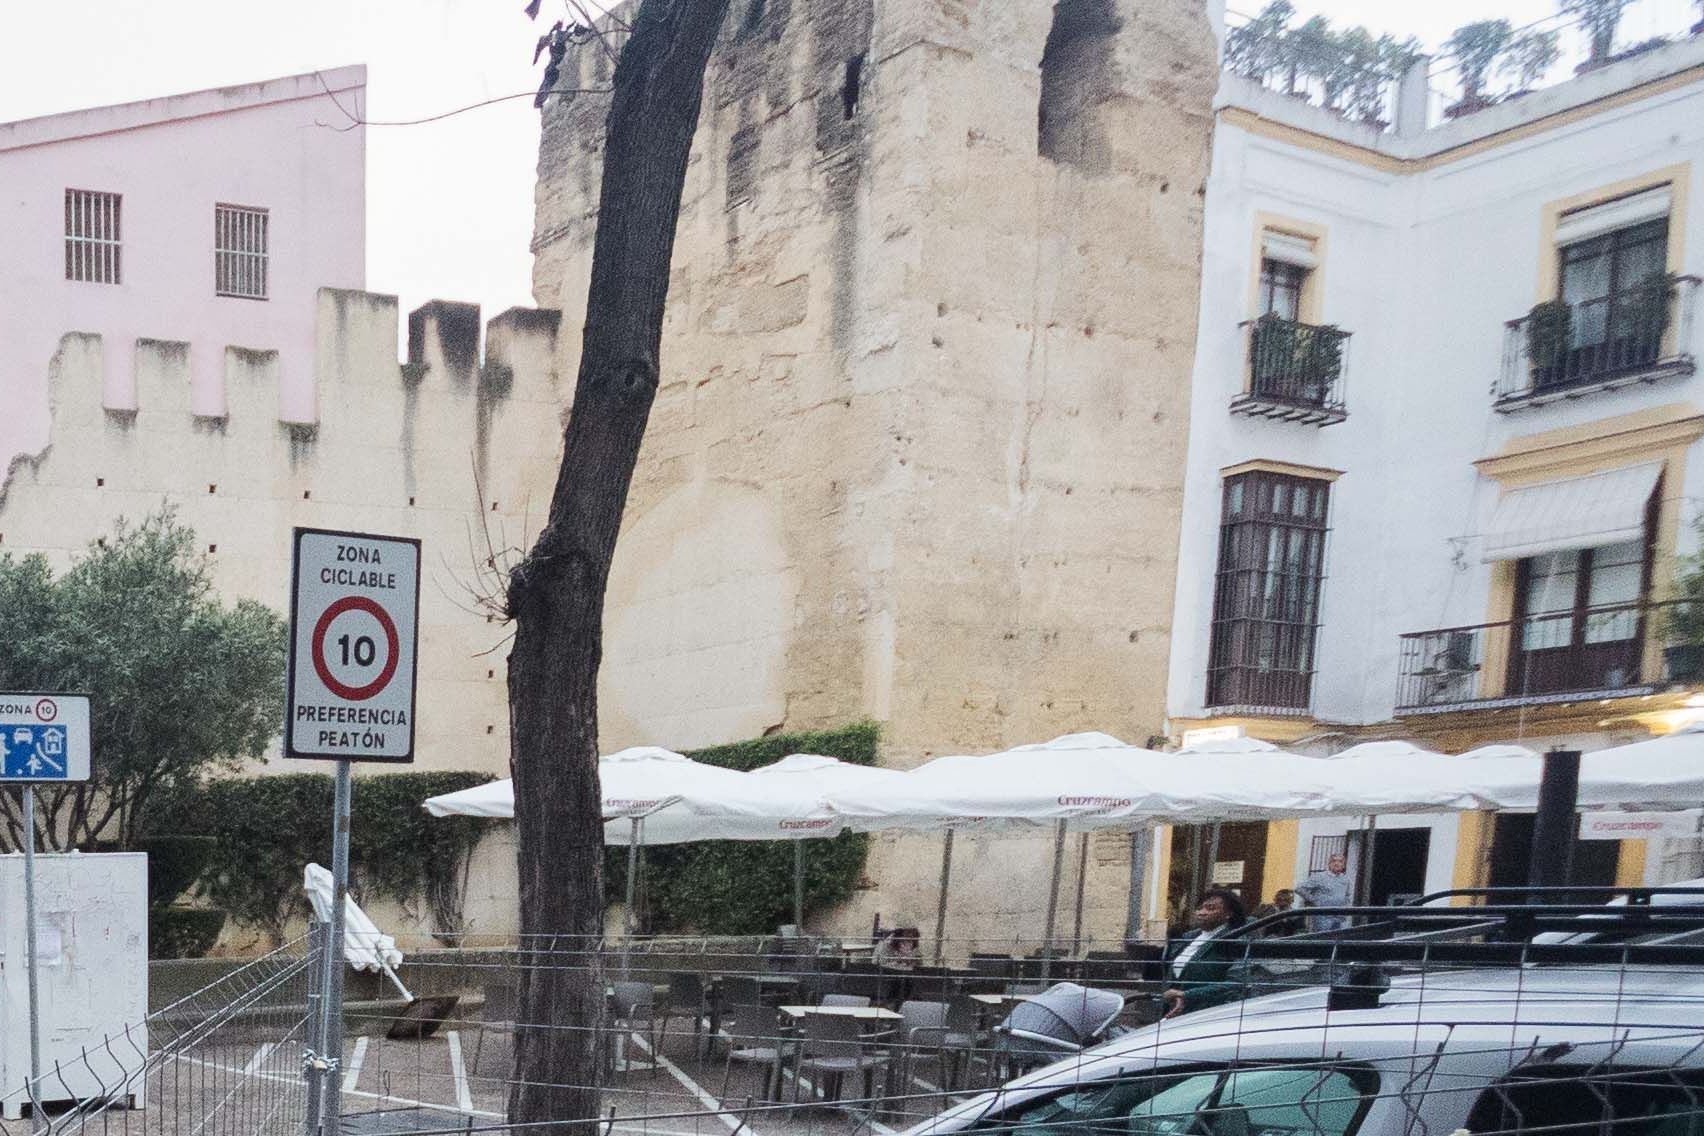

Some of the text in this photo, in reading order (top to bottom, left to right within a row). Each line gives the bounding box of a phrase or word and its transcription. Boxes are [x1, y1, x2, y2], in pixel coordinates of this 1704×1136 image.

[337, 545, 382, 564] ZONA
[320, 568, 396, 589] CICLABLE
[338, 634, 376, 666] 10
[42, 706, 52, 715] 10
[296, 705, 407, 726] PREFERENCIA
[318, 727, 385, 749] PEATÓN
[1057, 795, 1131, 809] Cruzcampo
